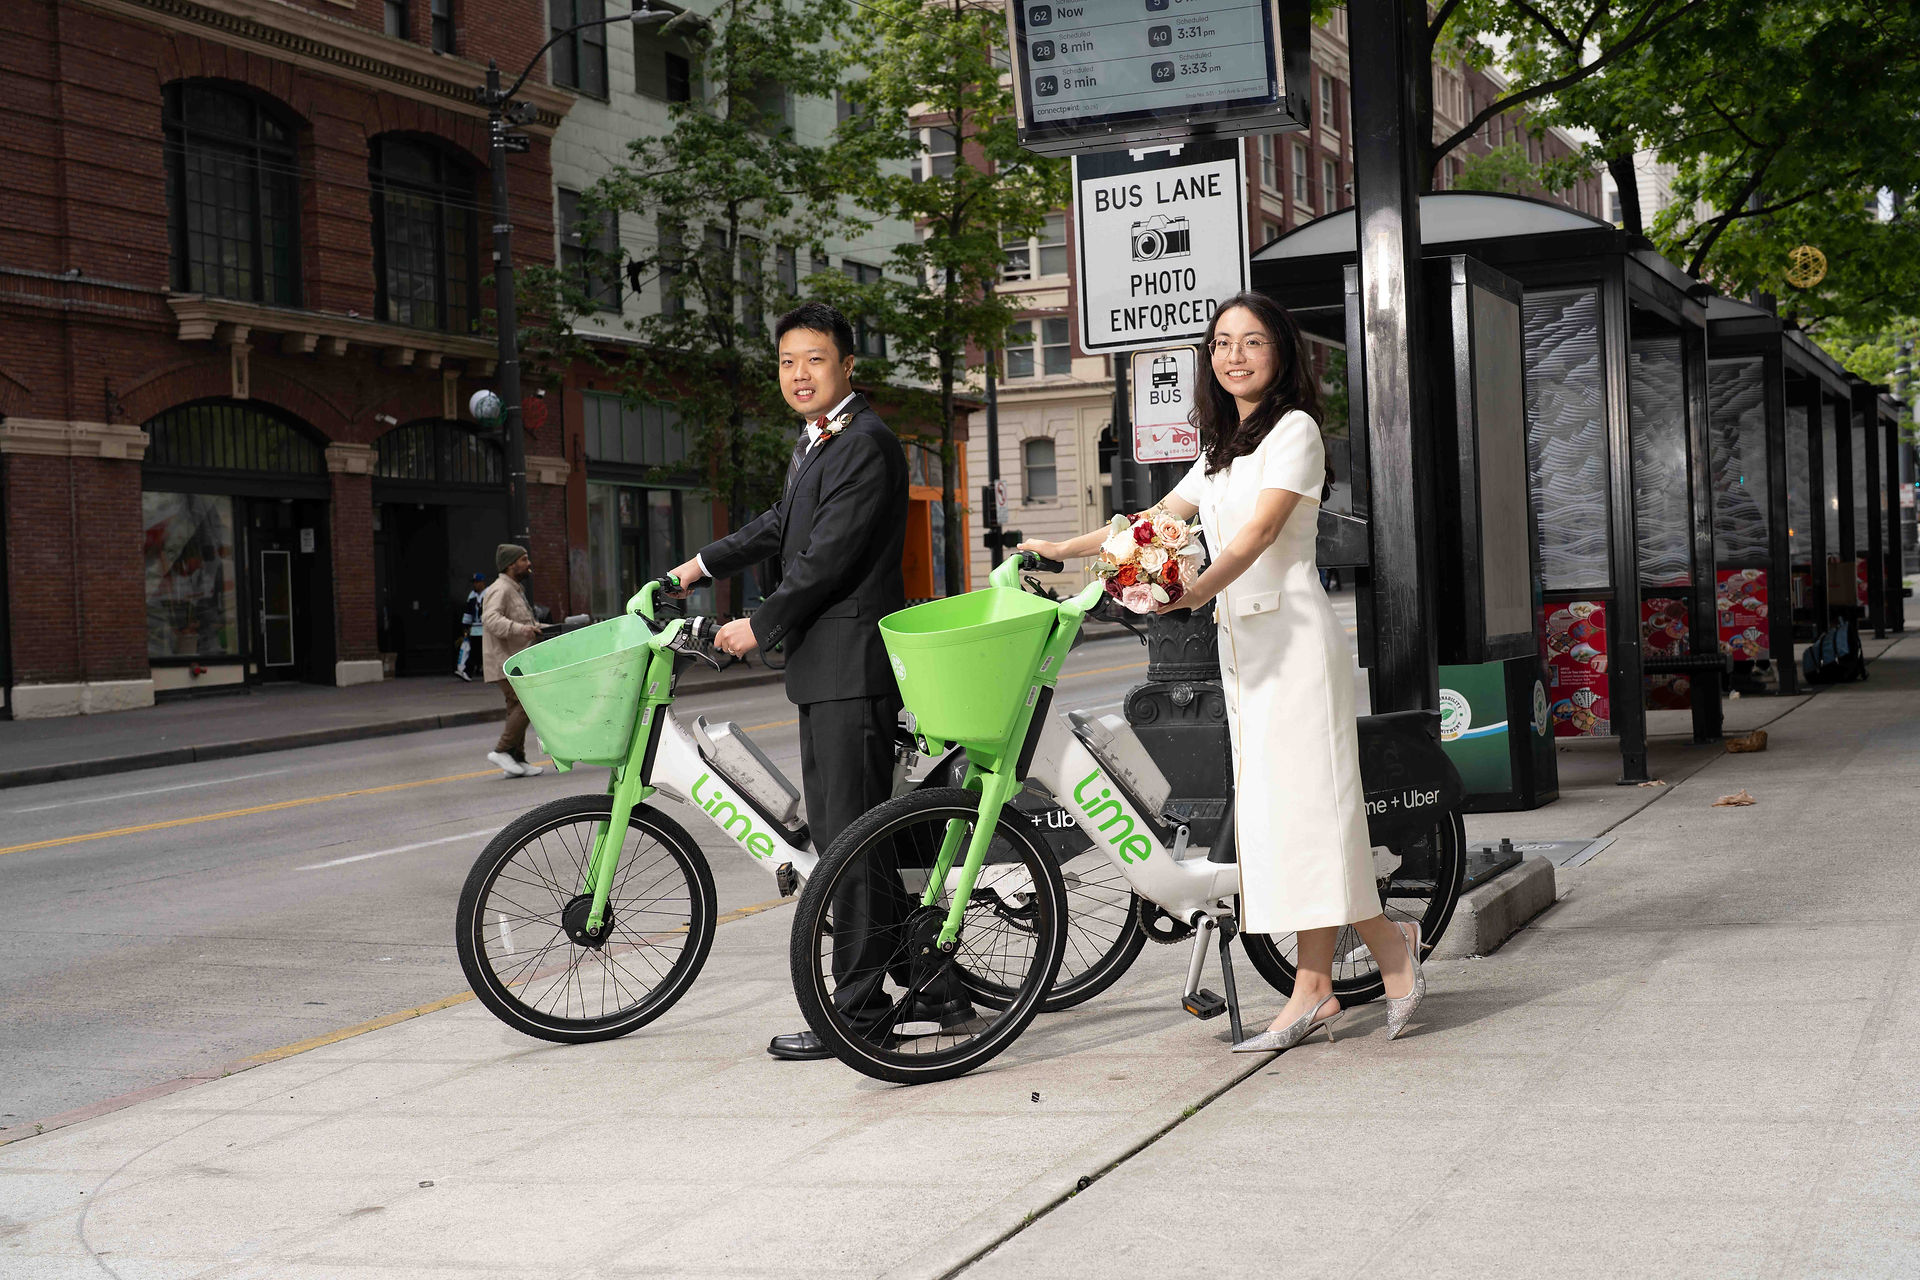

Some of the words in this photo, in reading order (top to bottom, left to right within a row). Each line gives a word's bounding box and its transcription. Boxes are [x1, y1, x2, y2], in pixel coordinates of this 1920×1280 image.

[1034, 10, 1047, 22] 62
[1058, 8, 1084, 19] Now
[1176, 16, 1208, 25] Scheduled
[1059, 31, 1090, 40] Scheduled
[1154, 32, 1167, 42] 40
[1178, 26, 1202, 39] 3:31
[1204, 29, 1216, 37] pm
[1037, 46, 1050, 57] 28
[1061, 43, 1068, 53] 8
[1072, 40, 1094, 52] min
[1179, 52, 1212, 61] Scheduled
[1062, 66, 1094, 75] Scheduled
[1156, 67, 1170, 78] 62
[1180, 62, 1208, 75] 3:33
[1209, 65, 1221, 73] pm
[1040, 82, 1054, 92] 24
[1064, 79, 1071, 89] 8
[1074, 76, 1096, 88] min
[1095, 184, 1143, 212] BUS
[1156, 173, 1222, 204] LANE
[1130, 267, 1196, 298] PHOTO
[1110, 298, 1217, 332] ENFORCED
[1150, 389, 1182, 405] BUS
[1364, 800, 1387, 815] me
[1403, 790, 1440, 808] Uber
[692, 773, 774, 860] Lime
[1047, 811, 1076, 828] Ub
[1074, 768, 1152, 864] Lime
